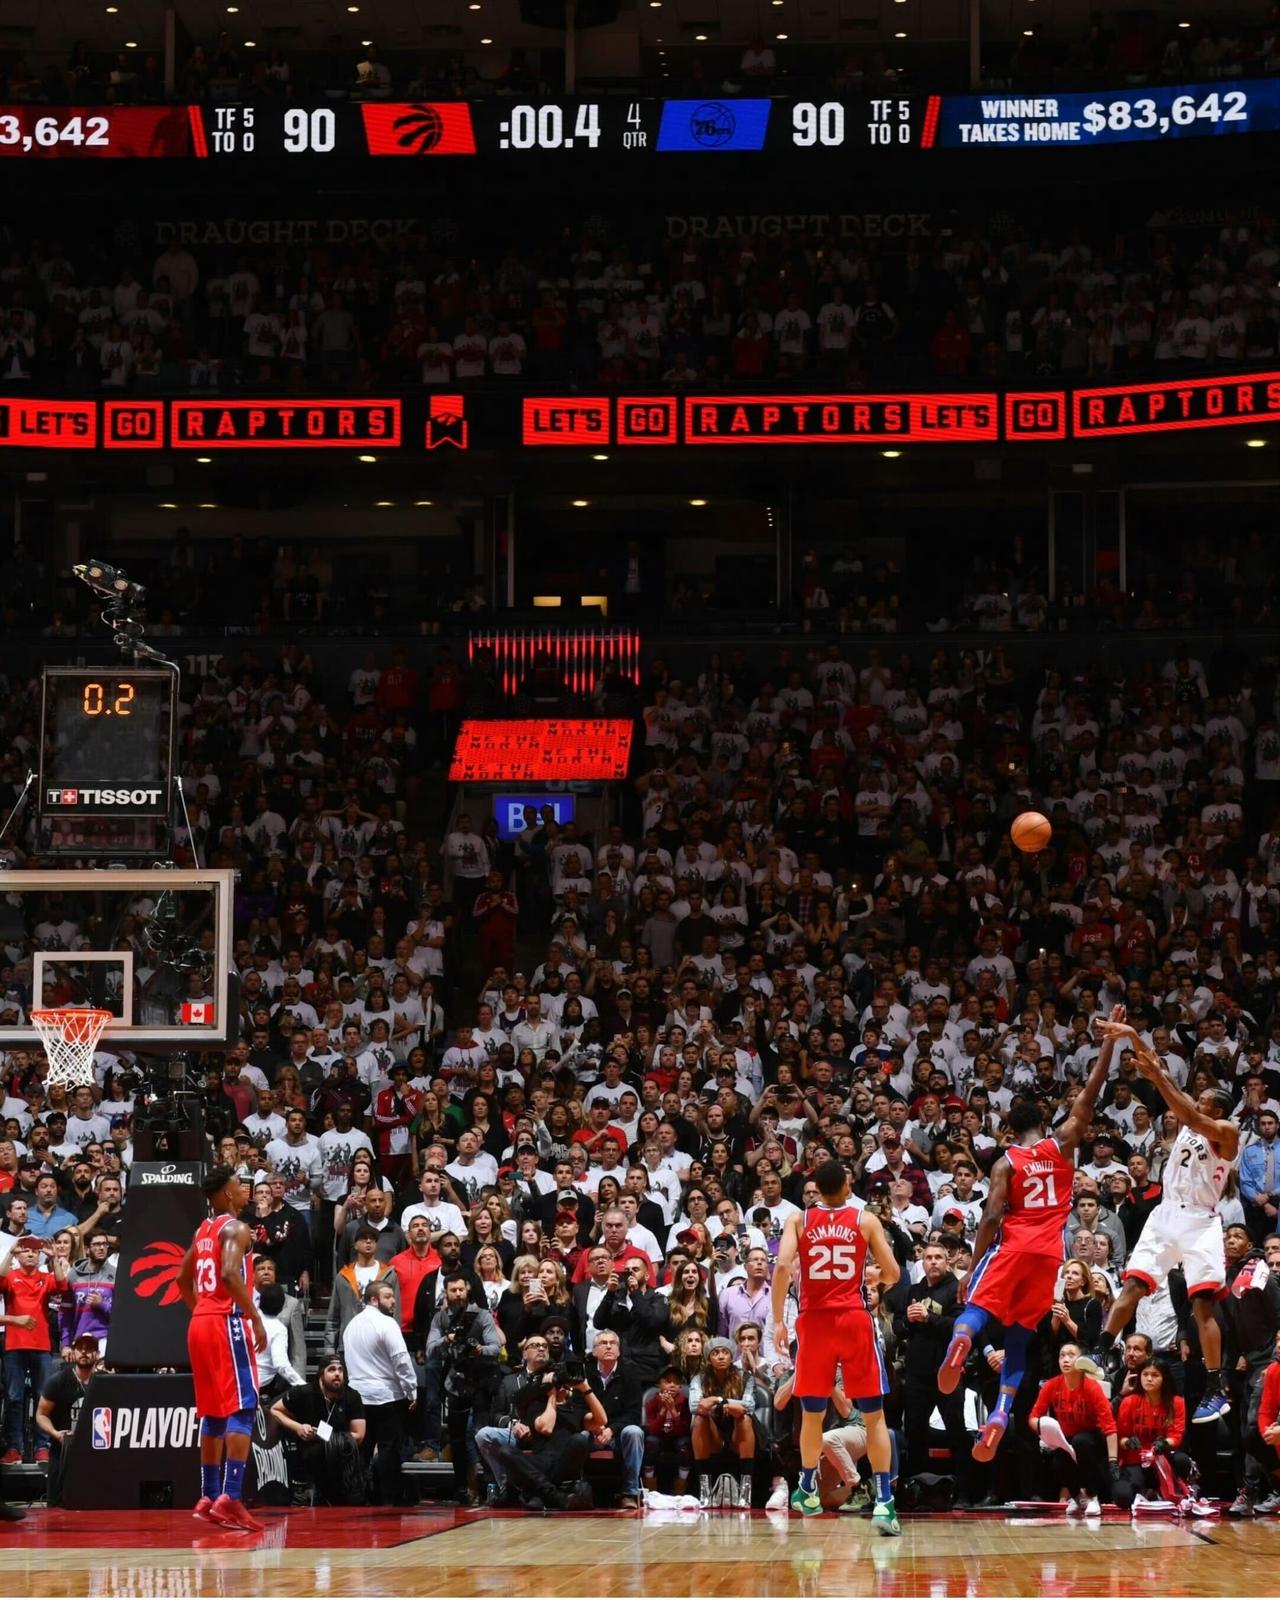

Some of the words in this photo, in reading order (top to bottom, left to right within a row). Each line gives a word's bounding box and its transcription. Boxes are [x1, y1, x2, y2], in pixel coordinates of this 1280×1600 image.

[215, 108, 236, 129] TF
[243, 108, 255, 128] 5
[627, 103, 642, 129] 4
[870, 100, 892, 121] TF
[898, 100, 910, 120] 5
[981, 99, 1059, 119] WINNER
[1082, 91, 1248, 136] $83,642
[284, 108, 336, 152] 90
[499, 103, 601, 149] :00.4
[792, 102, 845, 146] 90
[867, 123, 891, 145] TO
[898, 123, 910, 144] 0
[959, 123, 1020, 143] TAKES
[1024, 121, 1081, 142] HOME
[211, 131, 235, 153] TO
[243, 132, 255, 152] 0
[622, 131, 648, 150] QTR
[154, 218, 321, 246] DRAUGHT
[326, 217, 417, 243] DECK
[664, 215, 830, 240] DRAUGHT
[839, 213, 930, 239] DECK
[533, 407, 602, 433] LET'S
[630, 407, 665, 432] GO
[701, 404, 902, 433] RAPTORS
[921, 403, 991, 429] LET'S
[1018, 403, 1054, 428] GO
[1088, 382, 1280, 426] RAPTORS
[20, 410, 89, 436] LET'S
[116, 411, 151, 437] GO
[186, 409, 386, 437] RAPTORS
[84, 683, 134, 715] 0.2
[547, 728, 616, 736] NORTH
[548, 721, 567, 729] WE
[580, 721, 612, 729] THE
[465, 763, 487, 771] WE
[498, 763, 534, 771] THE
[542, 755, 612, 763] NORTH
[463, 771, 534, 779] NORTH
[49, 791, 60, 803] T
[79, 789, 162, 805] TISSOT
[1023, 1160, 1054, 1177] EMBIID
[1180, 1148, 1192, 1168] 2
[141, 1172, 194, 1185] SPALDING
[1023, 1174, 1058, 1208] 21
[806, 1224, 857, 1243] SIMMONS
[808, 1245, 857, 1280] 25
[196, 1257, 217, 1292] 23
[114, 1406, 201, 1449] PLAYOF
